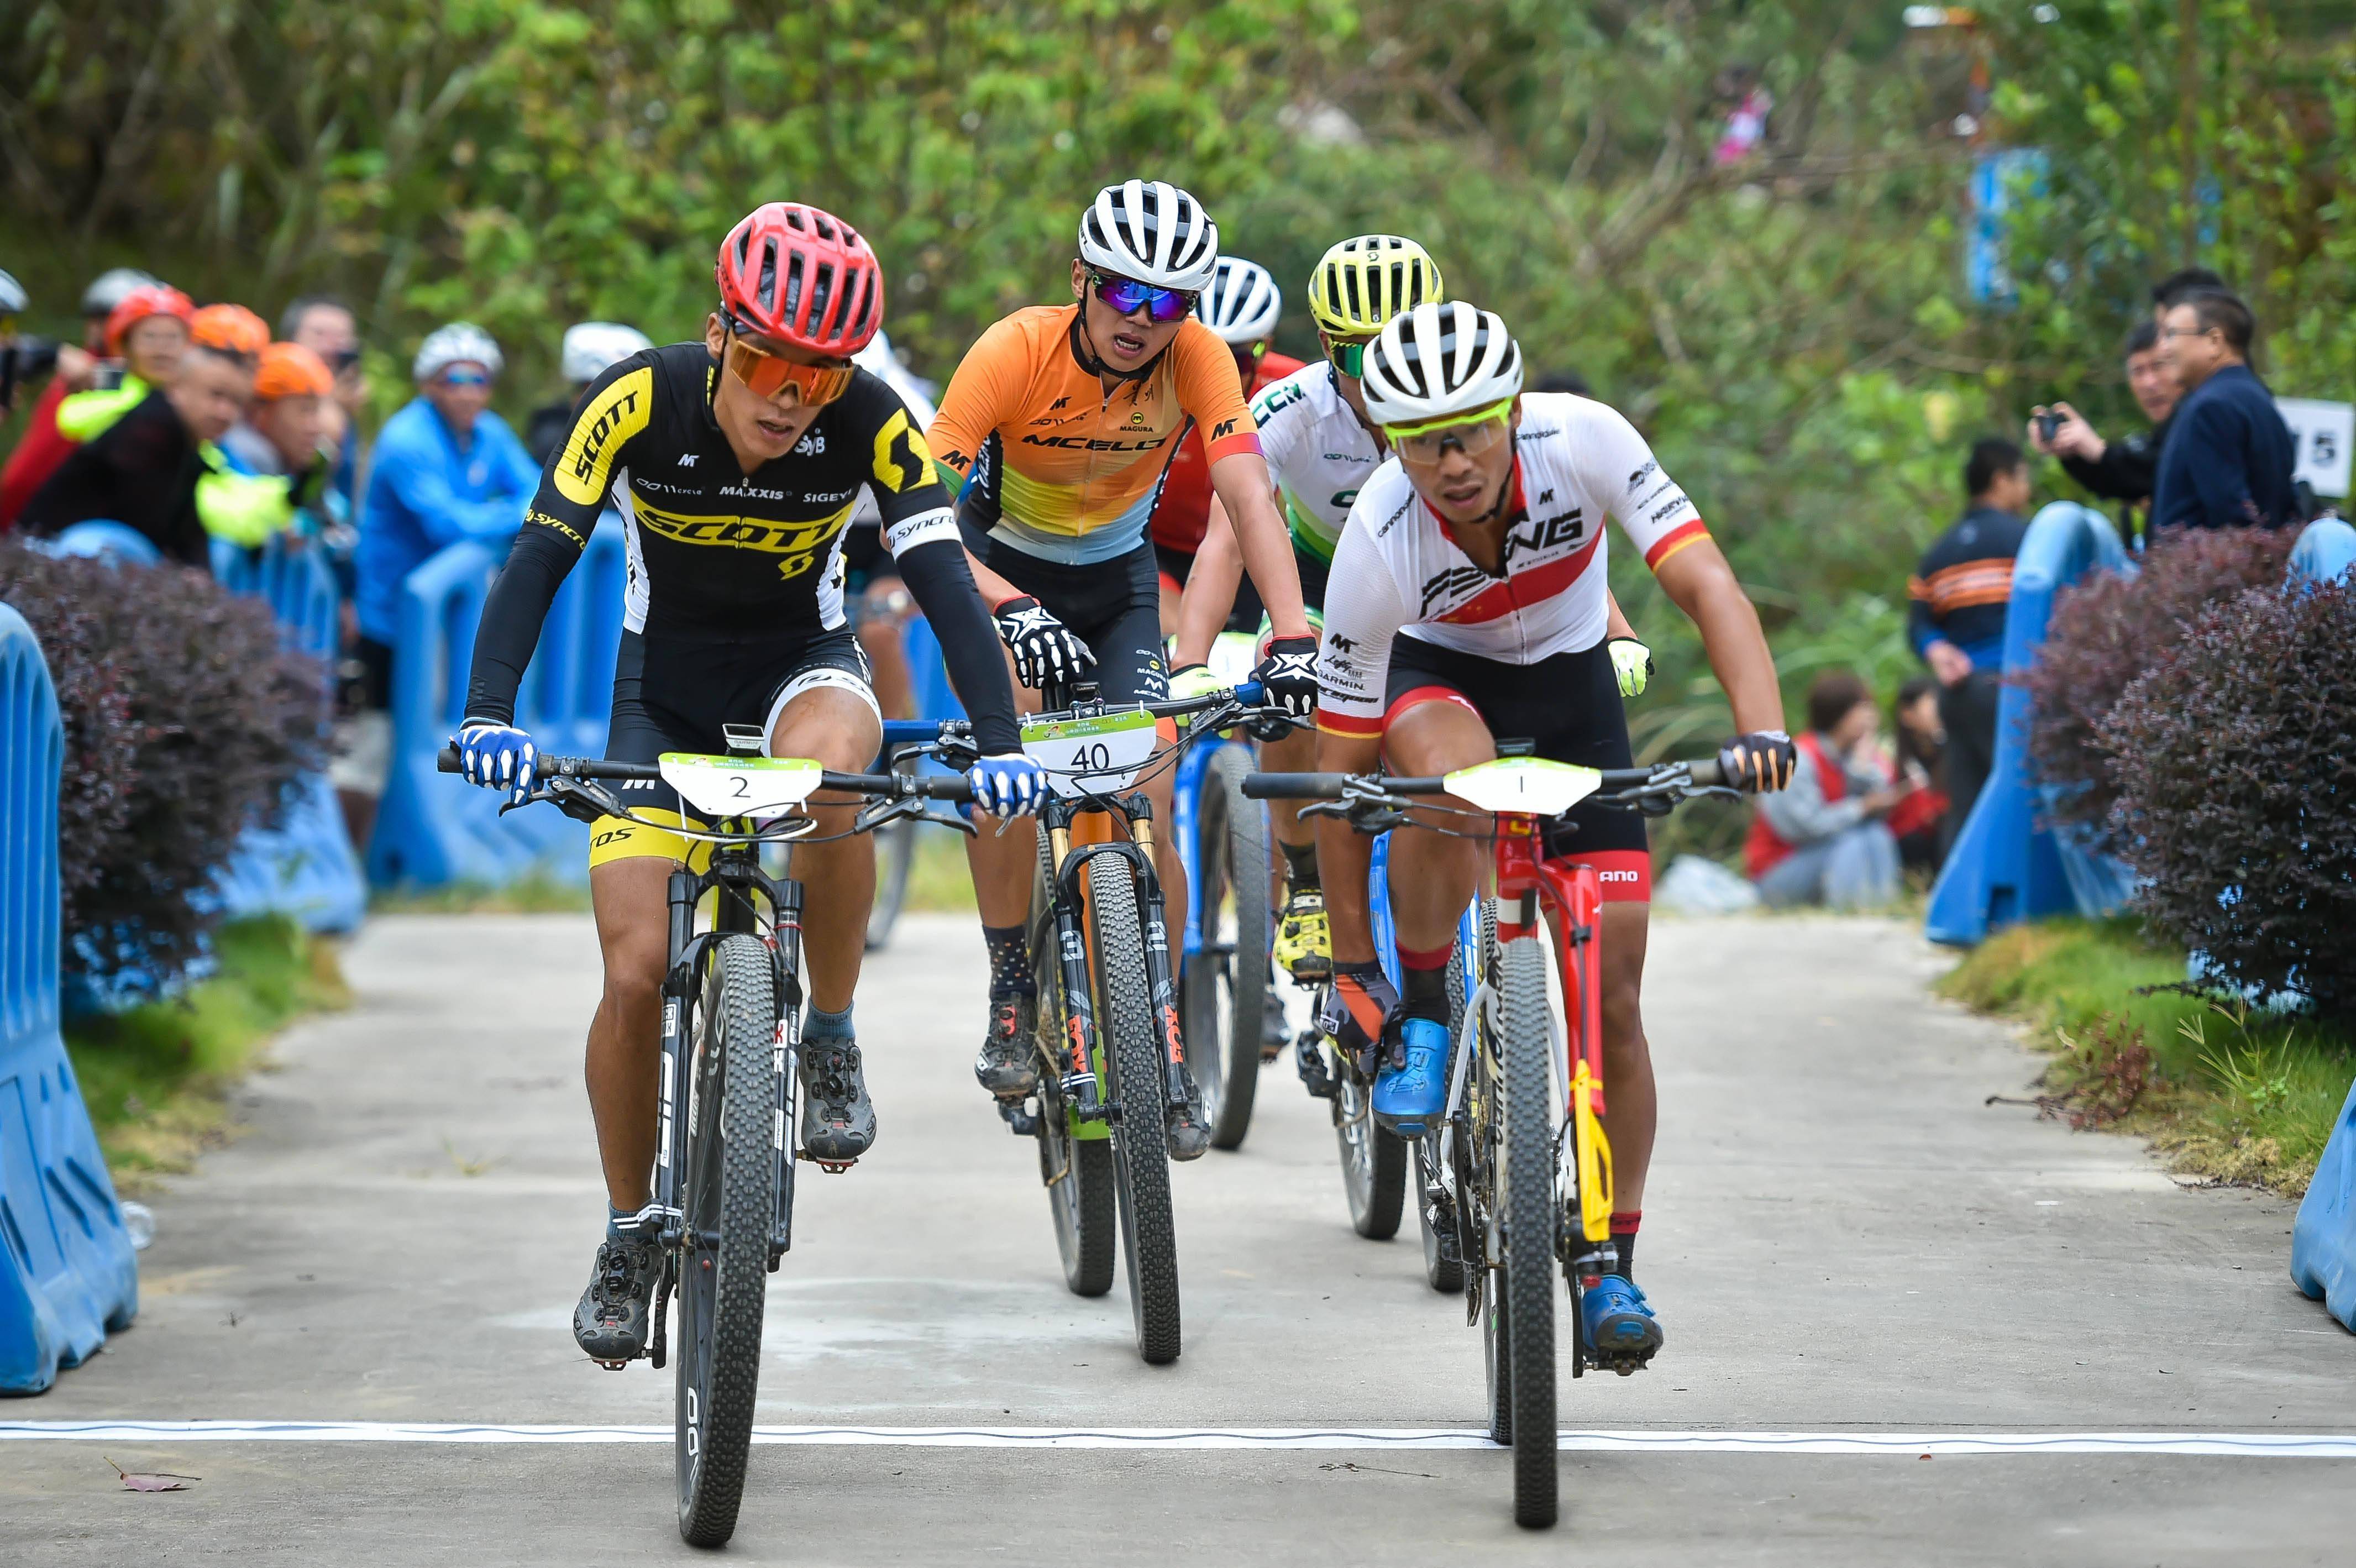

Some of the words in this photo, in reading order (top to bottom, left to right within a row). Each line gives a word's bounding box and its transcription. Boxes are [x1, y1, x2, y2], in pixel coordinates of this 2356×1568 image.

[574, 390, 638, 486] SCOTT
[719, 485, 784, 500] MAXXIS
[642, 508, 845, 548] SCOTT
[1071, 743, 1110, 773] 40
[730, 776, 751, 798] 2
